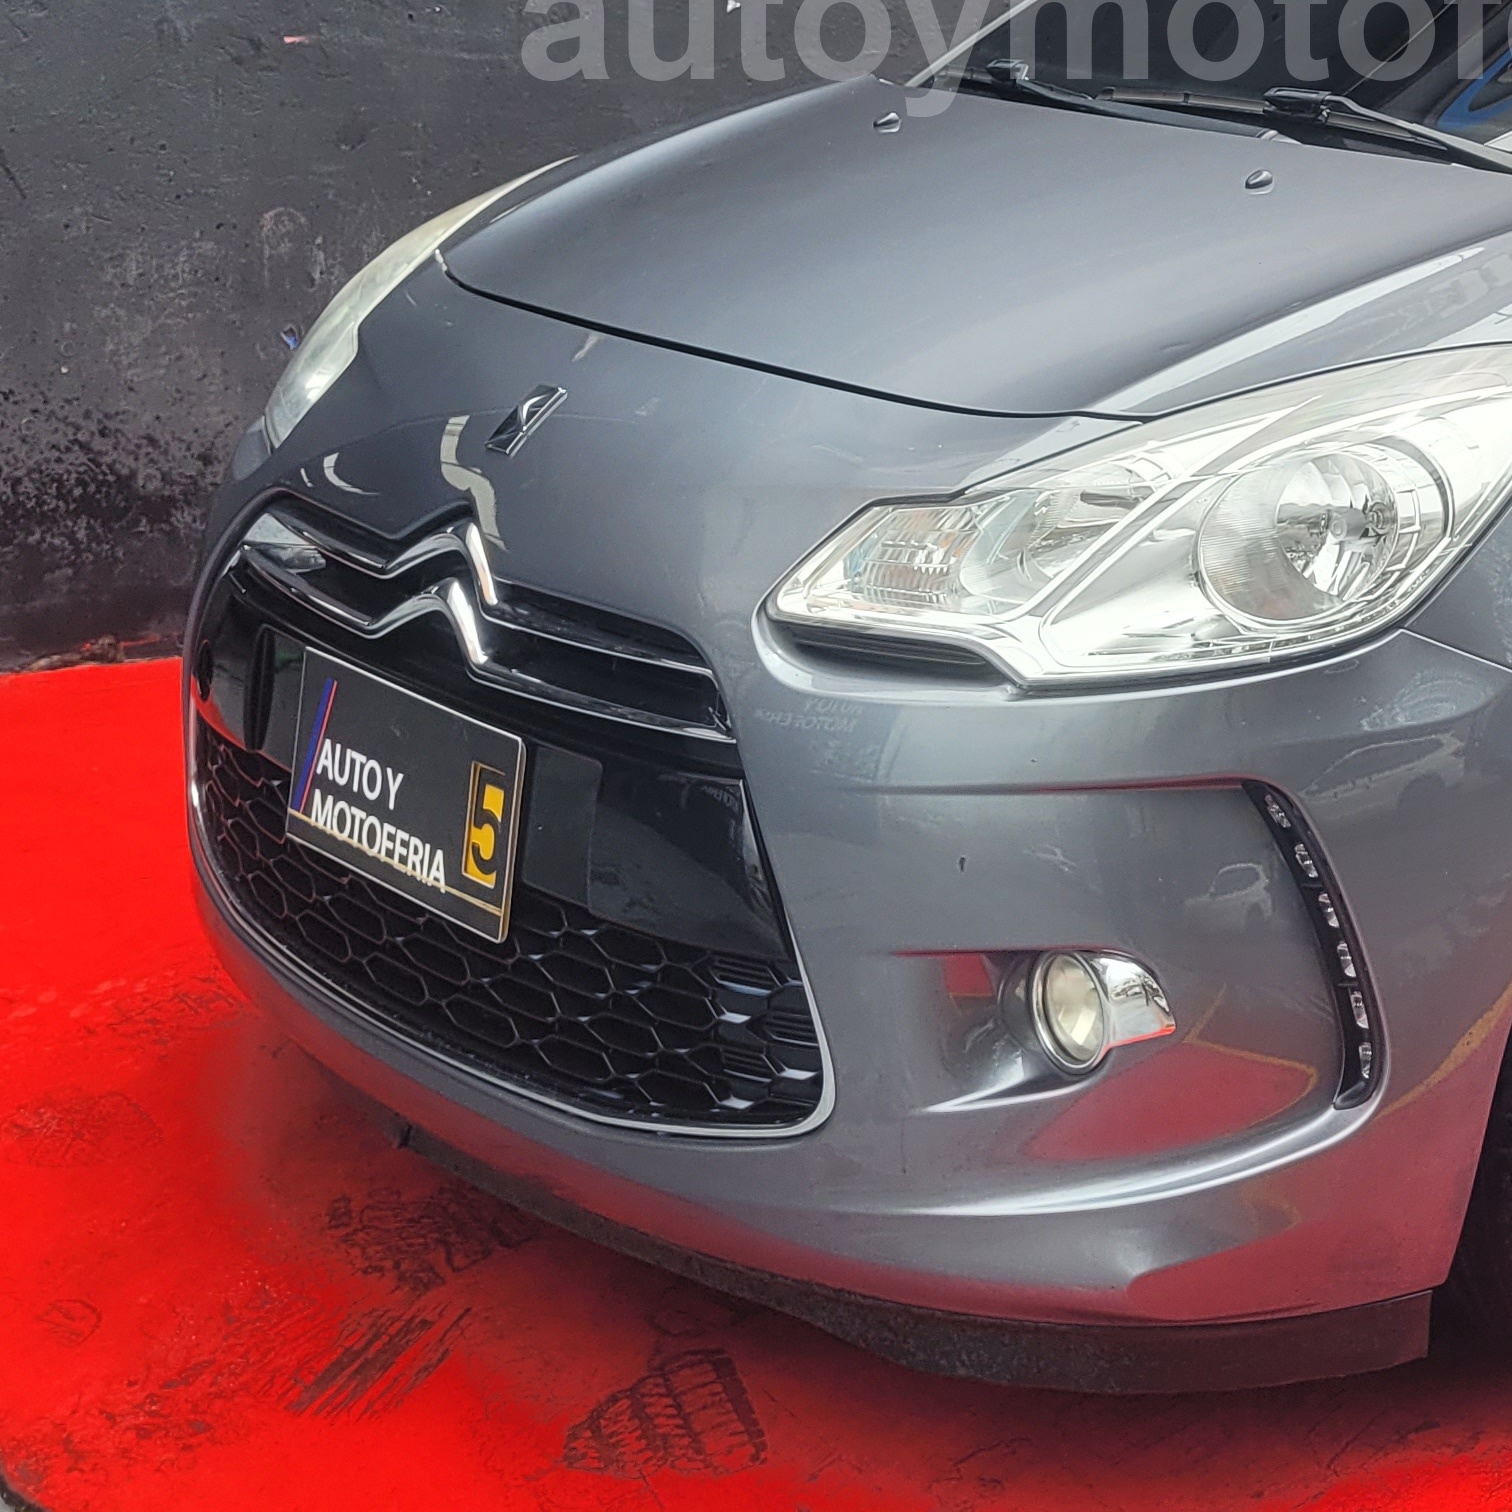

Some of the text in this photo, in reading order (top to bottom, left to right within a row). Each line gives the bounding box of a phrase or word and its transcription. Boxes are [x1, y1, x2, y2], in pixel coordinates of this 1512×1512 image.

[316, 738, 404, 810] AUTO Y
[311, 789, 446, 893] MOTOFERIA
